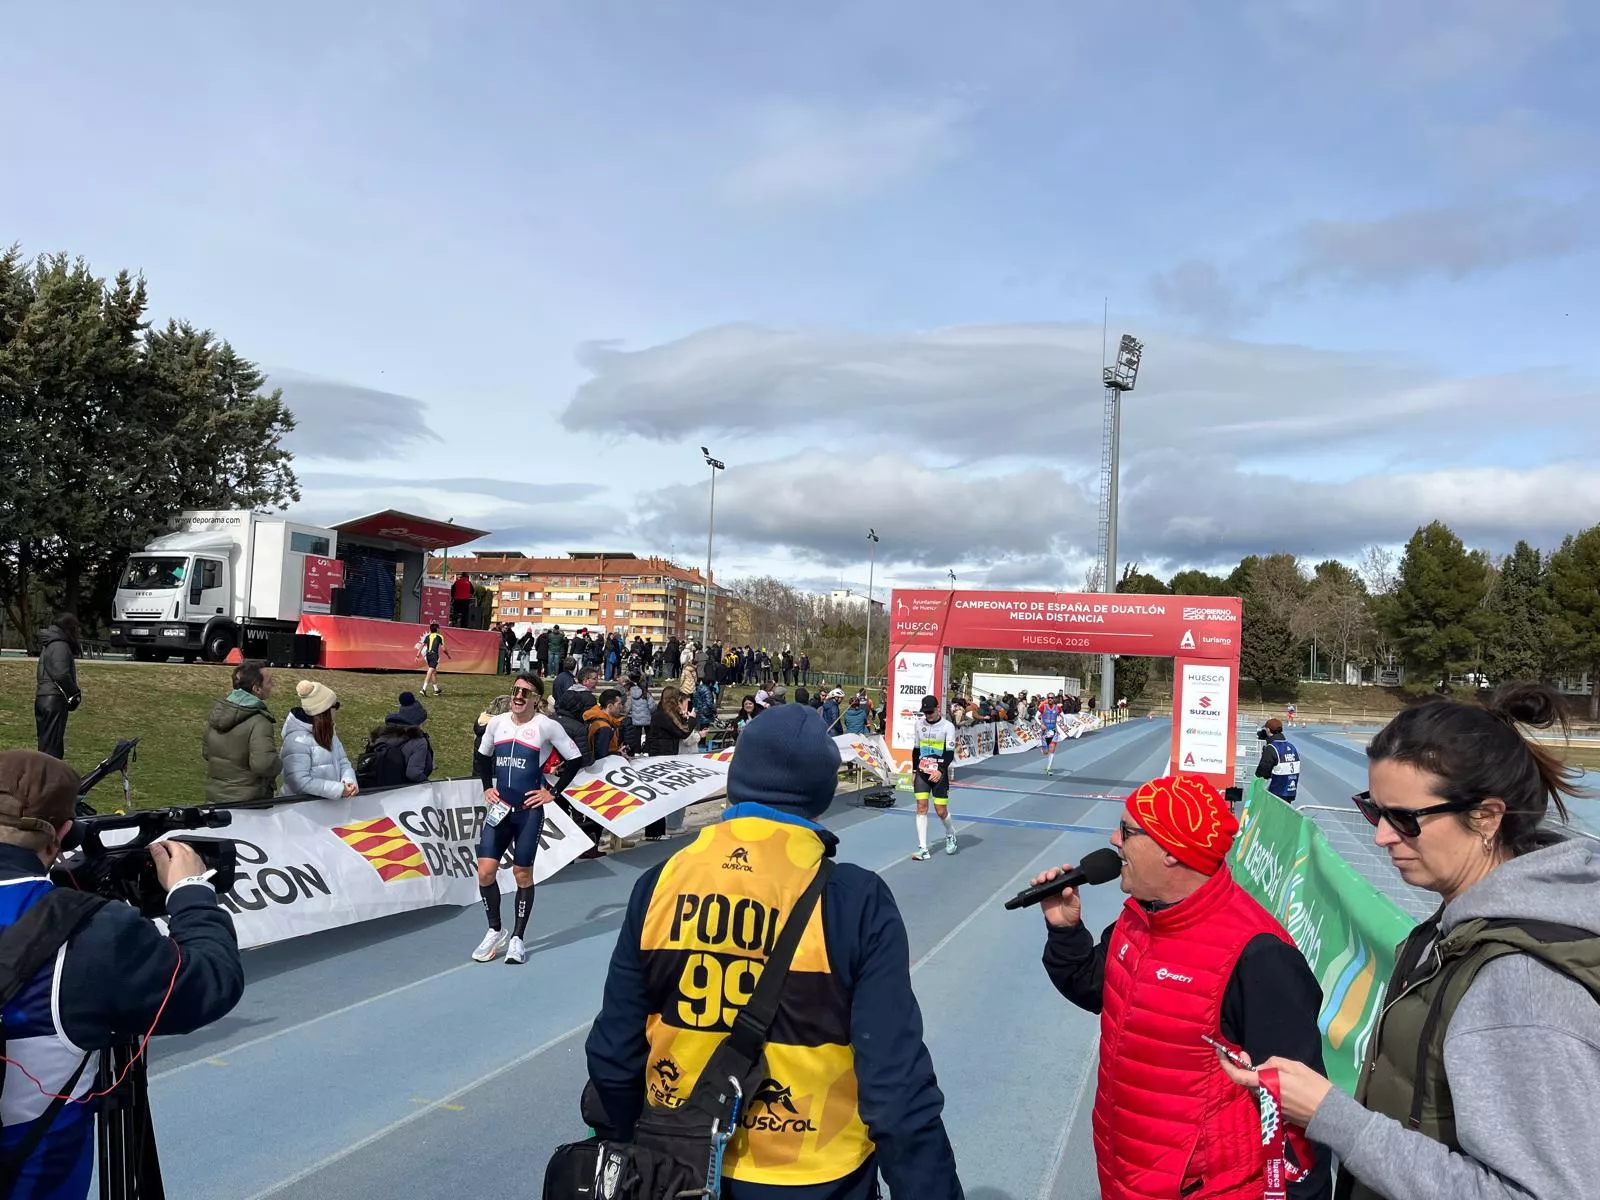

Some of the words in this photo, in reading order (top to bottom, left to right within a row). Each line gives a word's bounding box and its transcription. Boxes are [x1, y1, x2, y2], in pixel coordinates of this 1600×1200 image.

[955, 601, 1028, 610] CAMPEONATO
[1030, 602, 1045, 610] DE
[1047, 602, 1091, 612] ESPAÑA
[1093, 604, 1109, 613] DE
[1111, 604, 1165, 614] DUATLÓN
[1010, 611, 1043, 620] MEDIA
[1046, 613, 1104, 623] DISTANCIA
[897, 621, 939, 631] HUESCA
[1022, 636, 1063, 645] HUESCA
[1065, 638, 1090, 647] 2026
[1202, 636, 1232, 644] turismo
[1188, 674, 1225, 682] HUESCA
[900, 684, 927, 695] 226ERS
[1290, 763, 1295, 774] 3
[399, 806, 487, 842] GOBIER
[420, 842, 454, 877] DE
[1273, 1158, 1281, 1188] Huesca
